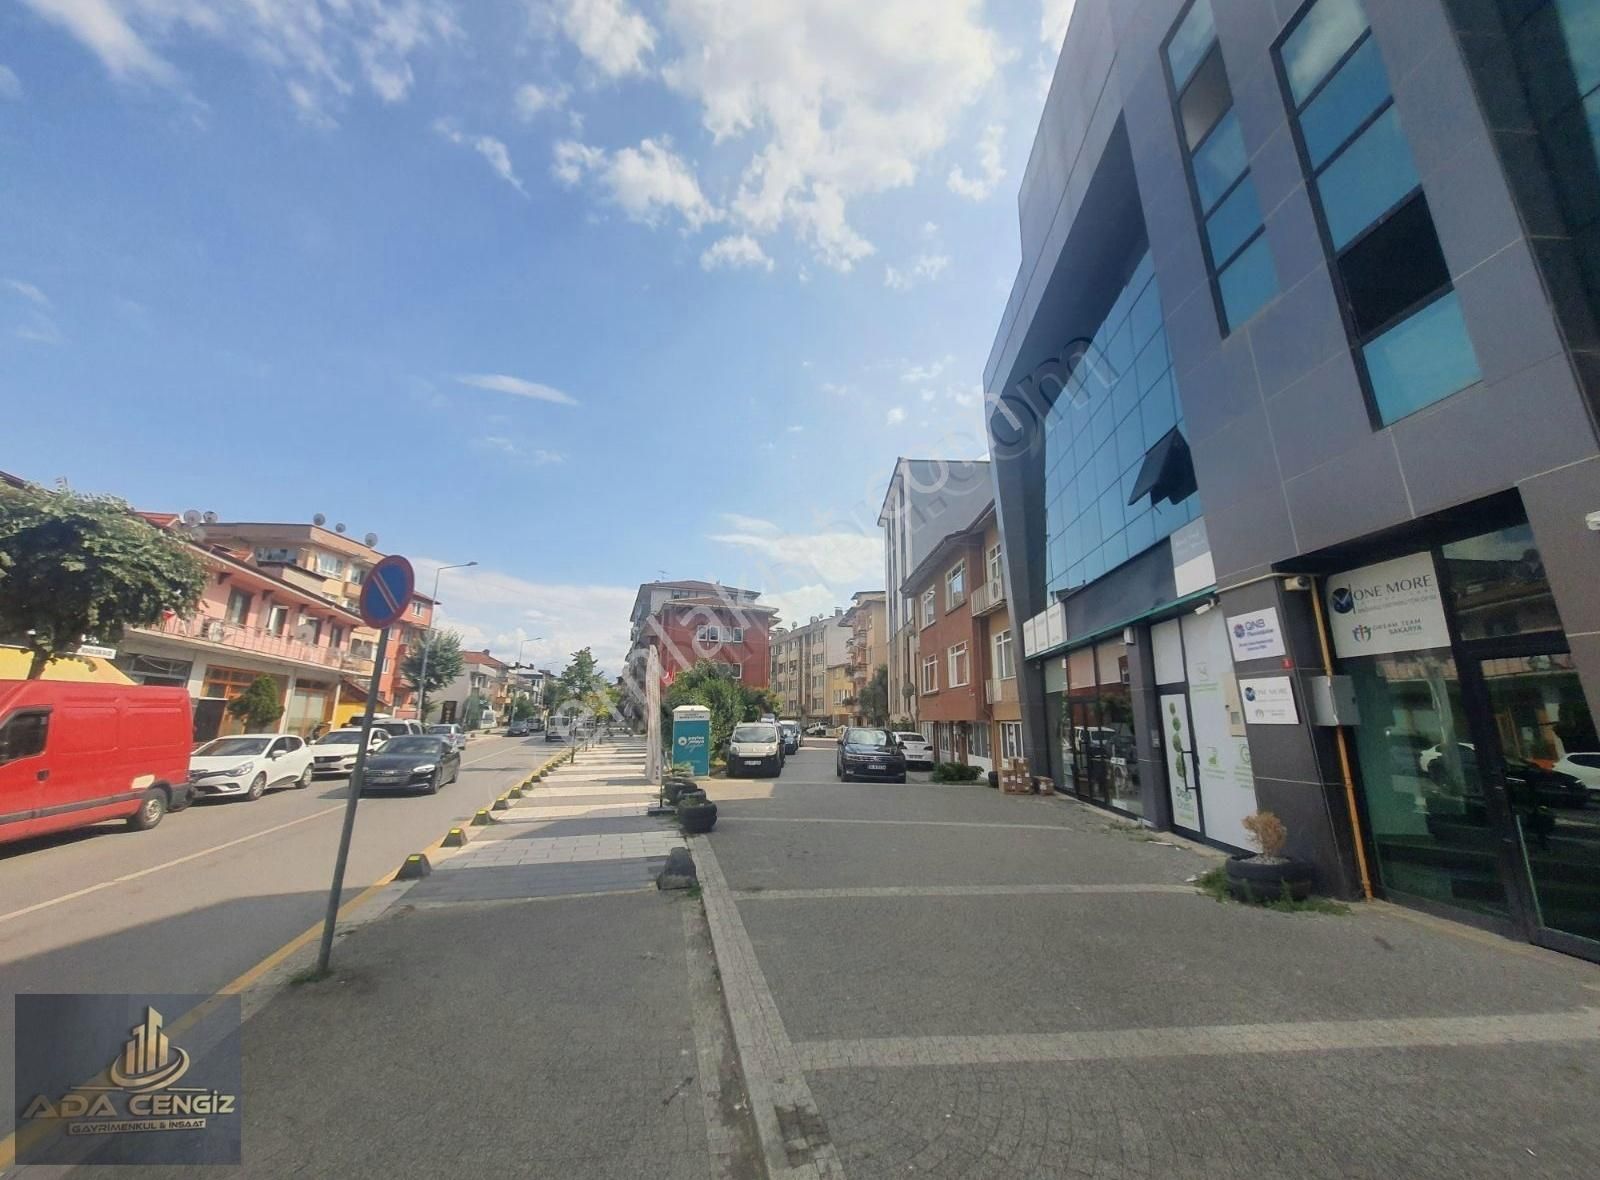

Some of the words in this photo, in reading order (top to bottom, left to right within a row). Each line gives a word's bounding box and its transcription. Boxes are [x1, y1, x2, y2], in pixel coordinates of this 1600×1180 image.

[1353, 585, 1383, 600] ONE
[1386, 574, 1433, 593] MORE
[1245, 618, 1266, 630] QNB
[1402, 617, 1421, 626] TEAM
[1389, 625, 1423, 635] SAKARYA
